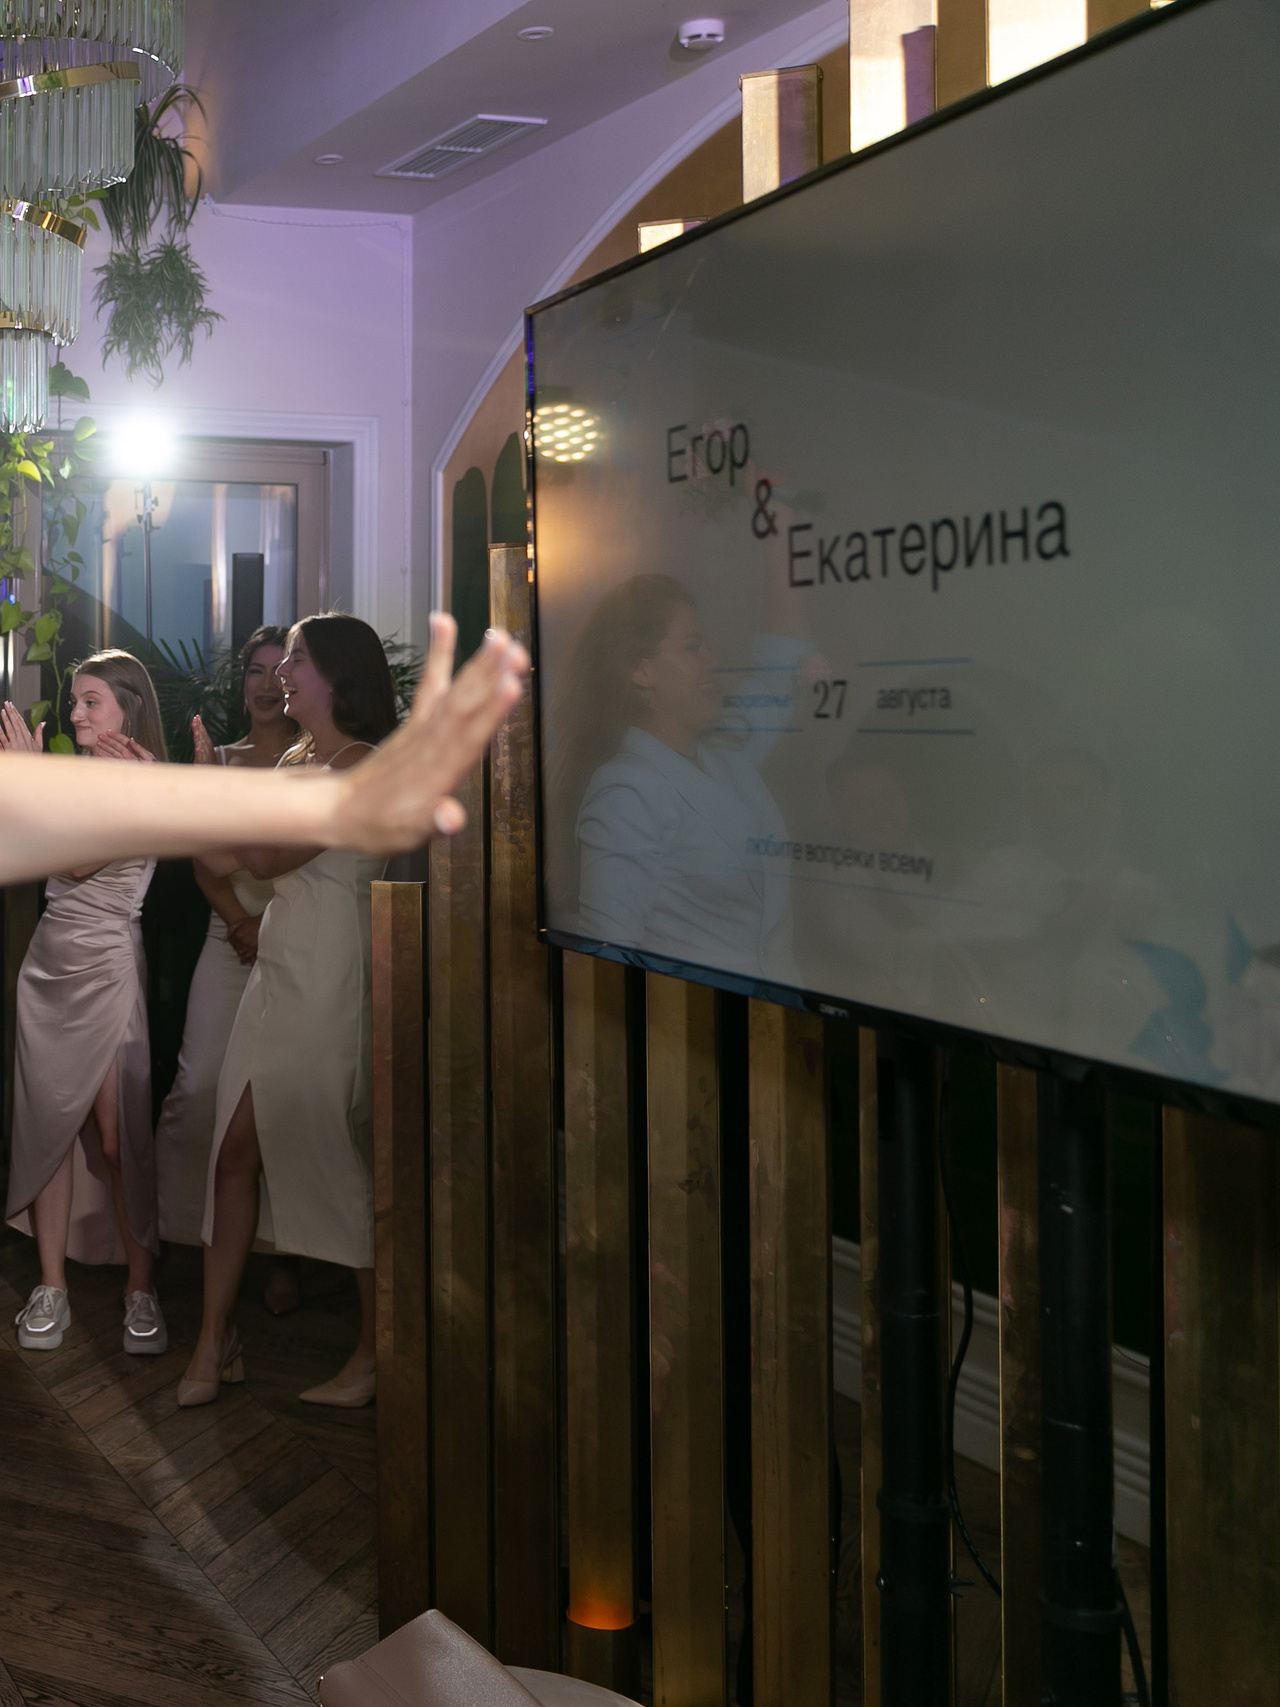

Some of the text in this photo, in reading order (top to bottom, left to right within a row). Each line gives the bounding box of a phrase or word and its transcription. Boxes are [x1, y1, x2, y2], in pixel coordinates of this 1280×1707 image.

[666, 422, 750, 486] Егор
[751, 478, 778, 539] &
[788, 500, 1071, 592] Екатерина
[813, 679, 848, 719] 27
[876, 686, 952, 716] августа
[879, 852, 934, 884] всему
